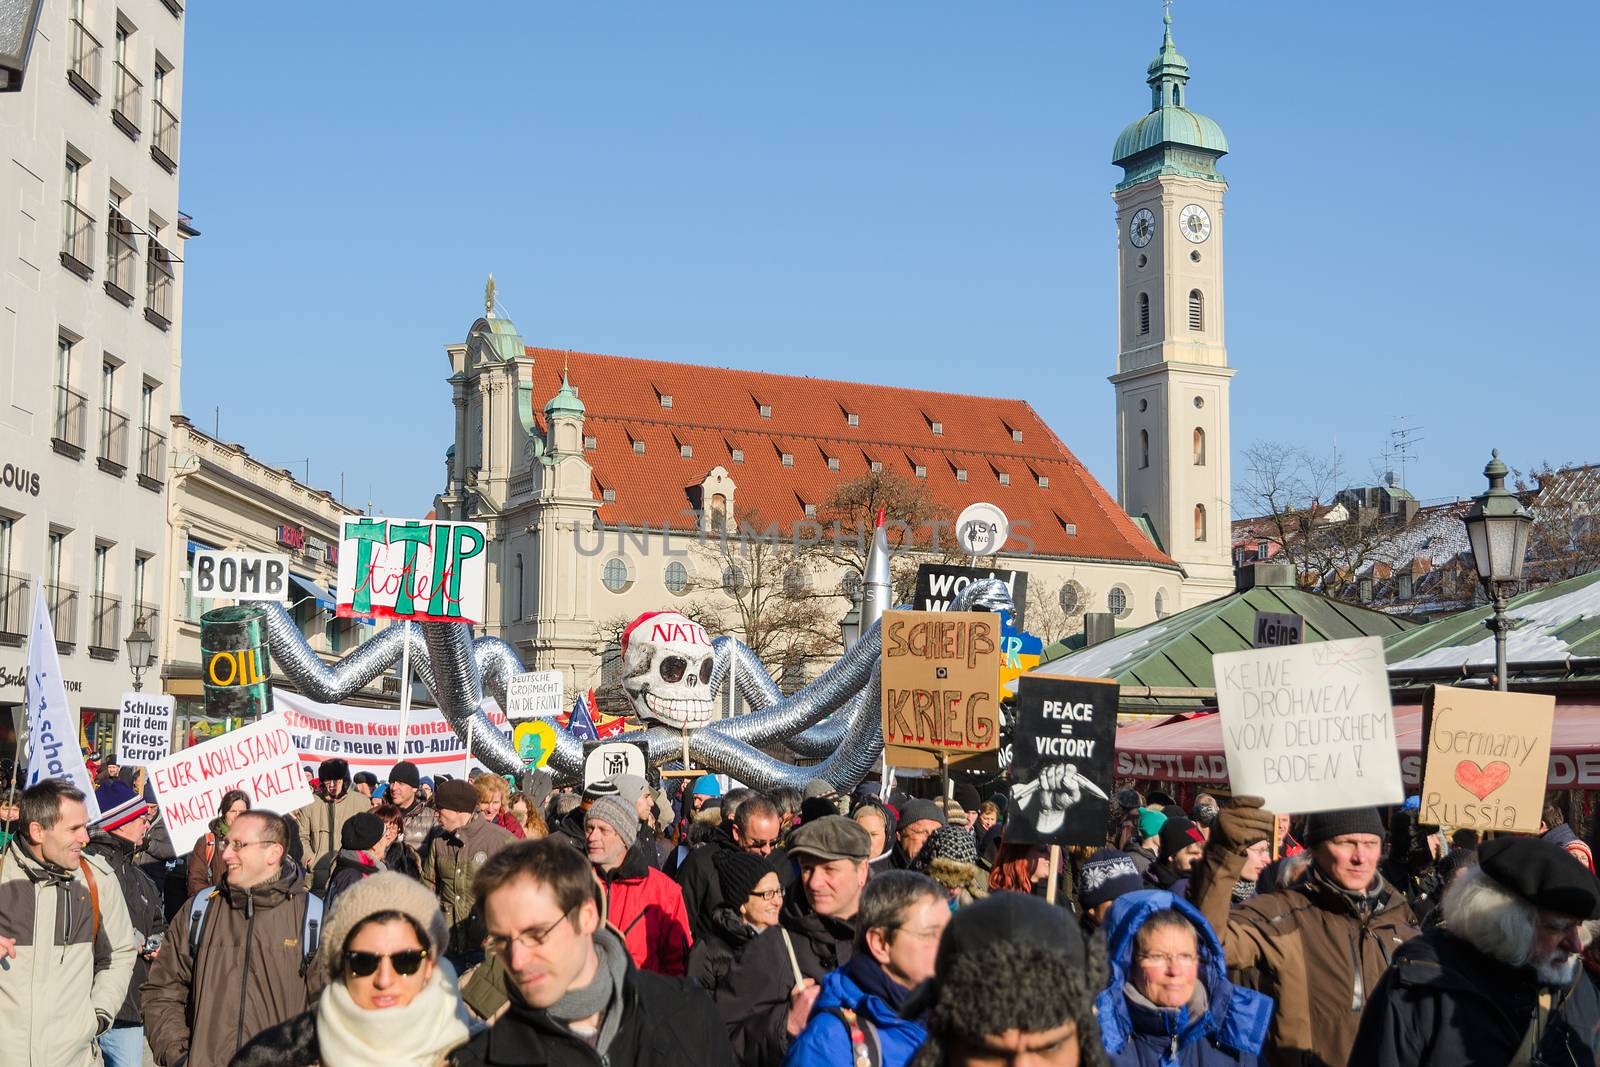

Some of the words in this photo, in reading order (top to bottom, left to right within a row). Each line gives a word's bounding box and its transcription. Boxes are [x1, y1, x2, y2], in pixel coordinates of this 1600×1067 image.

[0, 463, 40, 497] OUIS
[198, 556, 284, 594] BOMB
[345, 518, 485, 617] TTIP
[1258, 618, 1298, 645] Keine
[209, 650, 266, 686] OIL
[1224, 659, 1293, 690] KEINE
[123, 700, 169, 716] Schluss
[888, 688, 994, 747] KRIEG
[1042, 700, 1094, 721] PEACE
[1243, 684, 1360, 720] DROHNEN
[122, 730, 169, 747] Kriegs-
[123, 716, 141, 728] mit
[144, 717, 168, 731] dem
[335, 719, 364, 735] den
[1229, 723, 1274, 751] VON
[1285, 712, 1388, 748] DEUTSCHEM
[1433, 707, 1538, 767] Germany
[122, 745, 167, 761] Terror!
[292, 734, 312, 749] nd
[315, 736, 341, 752] die
[344, 740, 383, 754] neue
[1035, 736, 1096, 758] VICTORY
[155, 761, 198, 795] EUER
[199, 728, 291, 781] WOHLSTAND
[1117, 751, 1228, 779] SAFTLAD
[1263, 752, 1342, 785] BODEN
[165, 789, 216, 830] MACHT
[251, 762, 304, 803] KALT!
[1425, 791, 1517, 830] Russia
